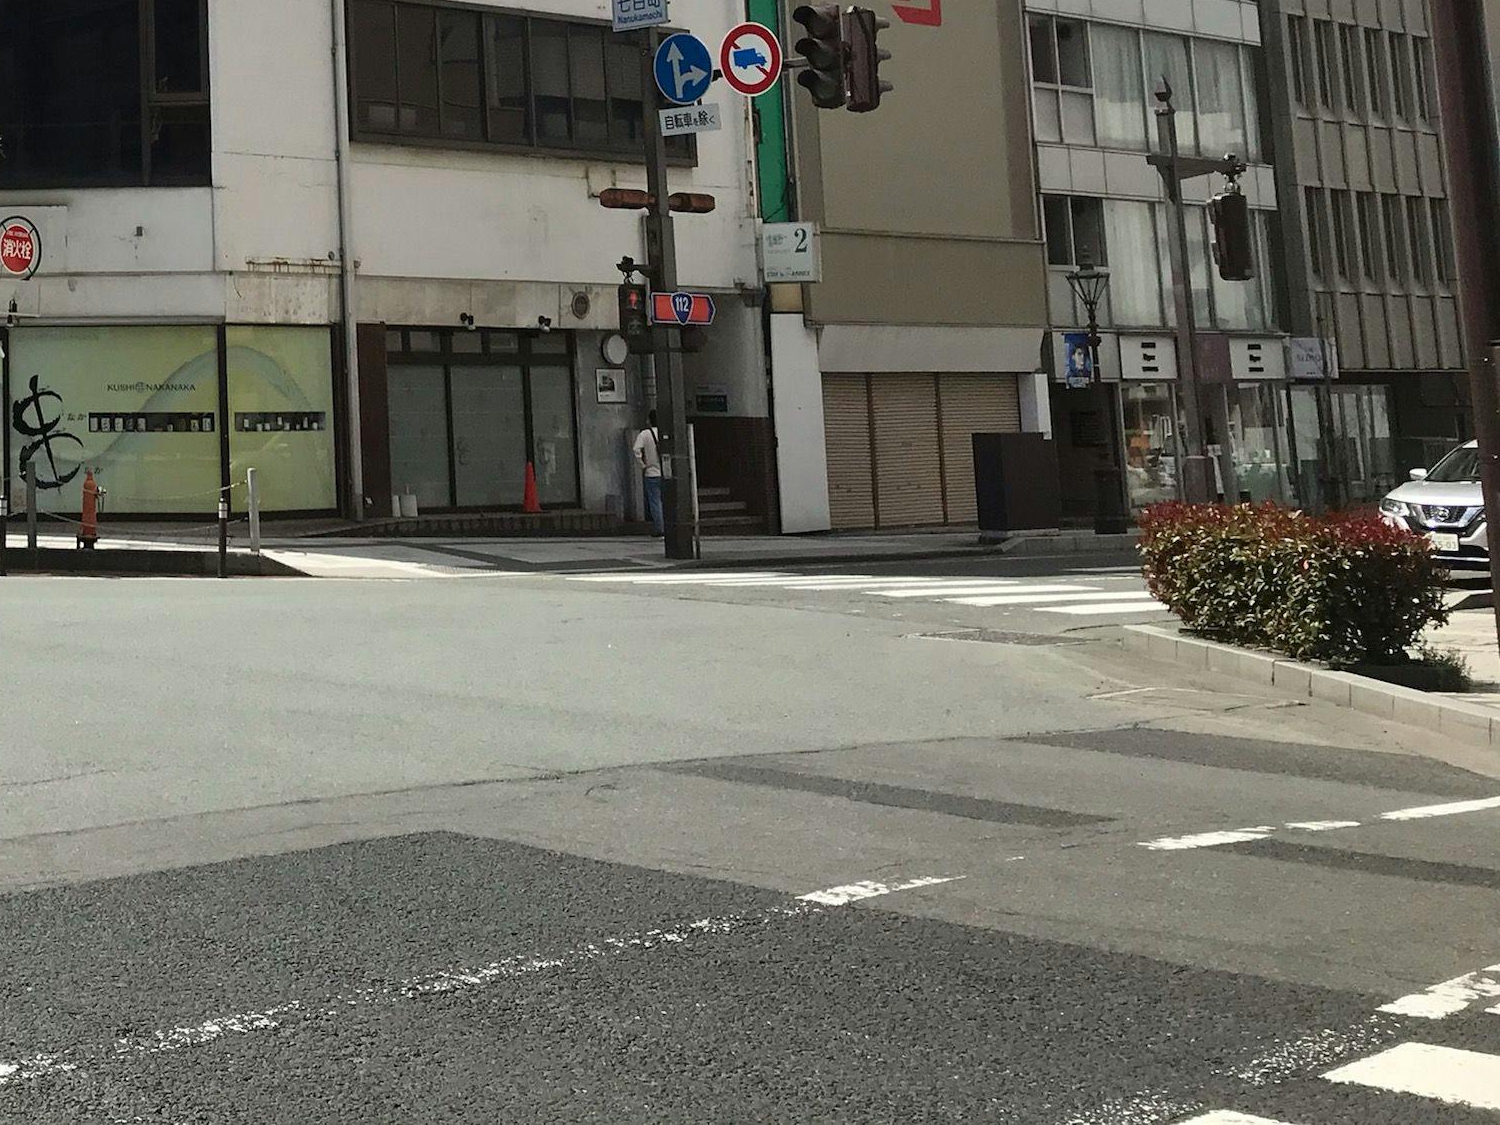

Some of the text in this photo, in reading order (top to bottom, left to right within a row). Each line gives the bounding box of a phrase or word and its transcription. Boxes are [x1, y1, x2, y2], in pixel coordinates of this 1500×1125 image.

[617, 9, 663, 24] Nanukamachi
[664, 110, 716, 130] 自転車を除く
[3, 238, 32, 260] 消火栓
[794, 228, 808, 253] 2
[674, 297, 689, 312] 112
[145, 383, 196, 391] NAKANAKA
